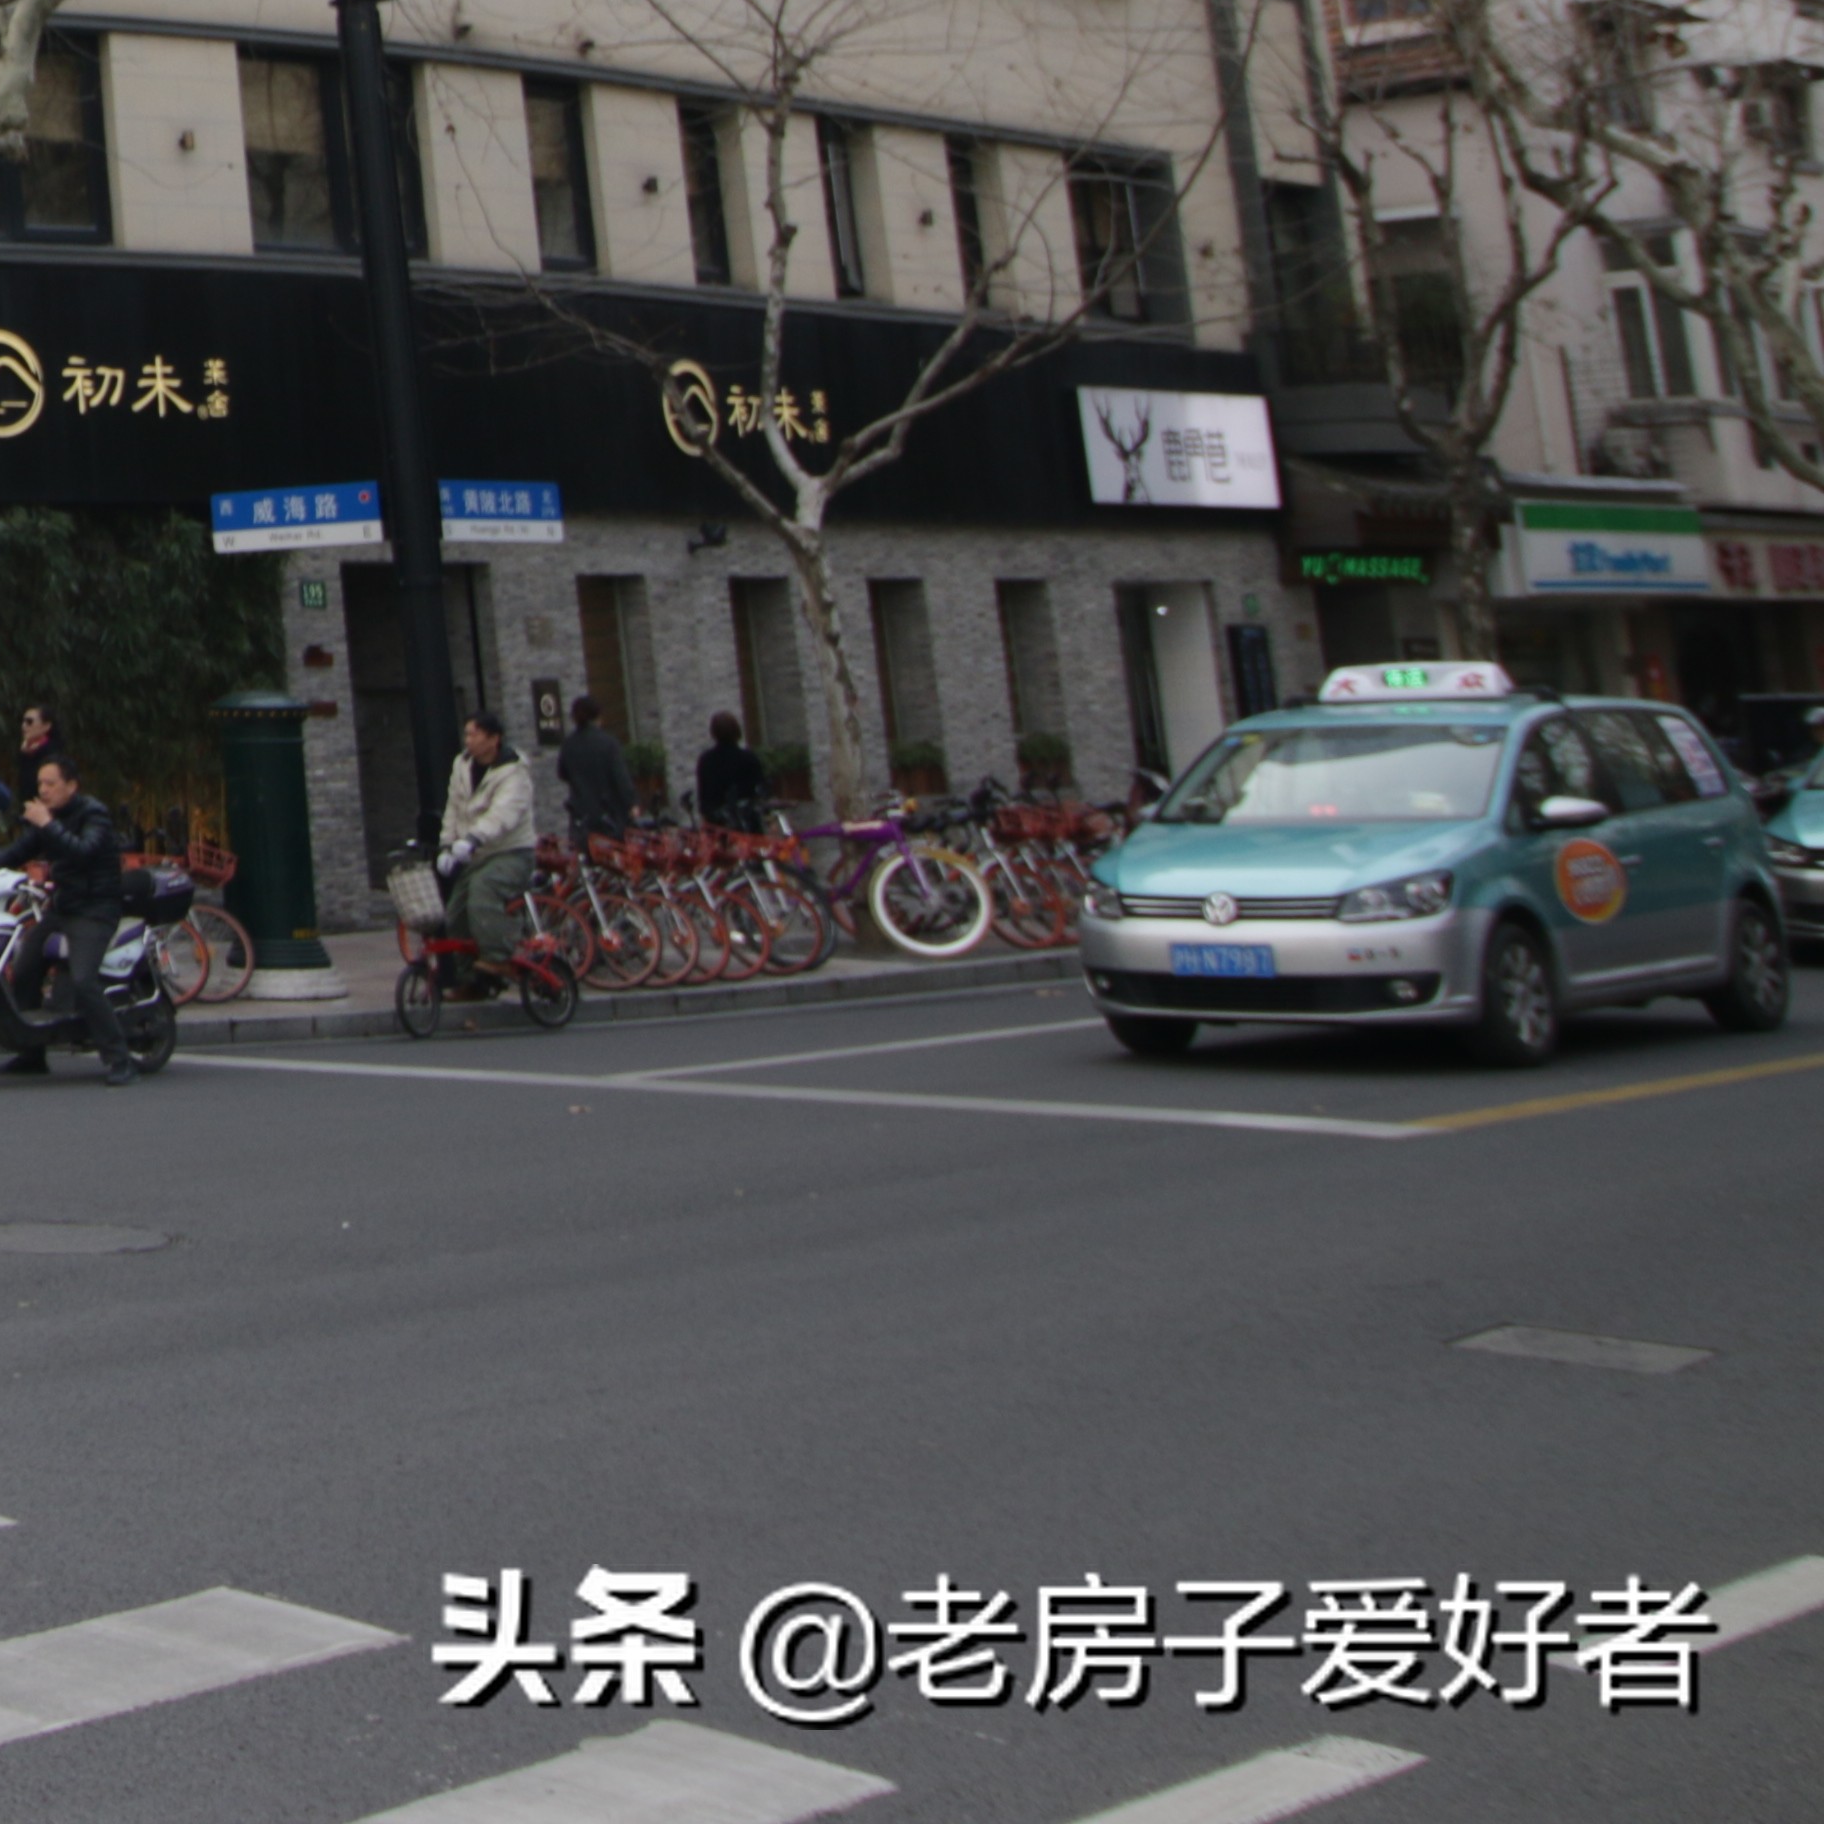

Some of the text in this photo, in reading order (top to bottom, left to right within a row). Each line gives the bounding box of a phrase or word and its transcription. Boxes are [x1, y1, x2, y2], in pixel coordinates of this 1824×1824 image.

[252, 492, 338, 525] 威海路
[463, 488, 532, 516] 黄陂北路
